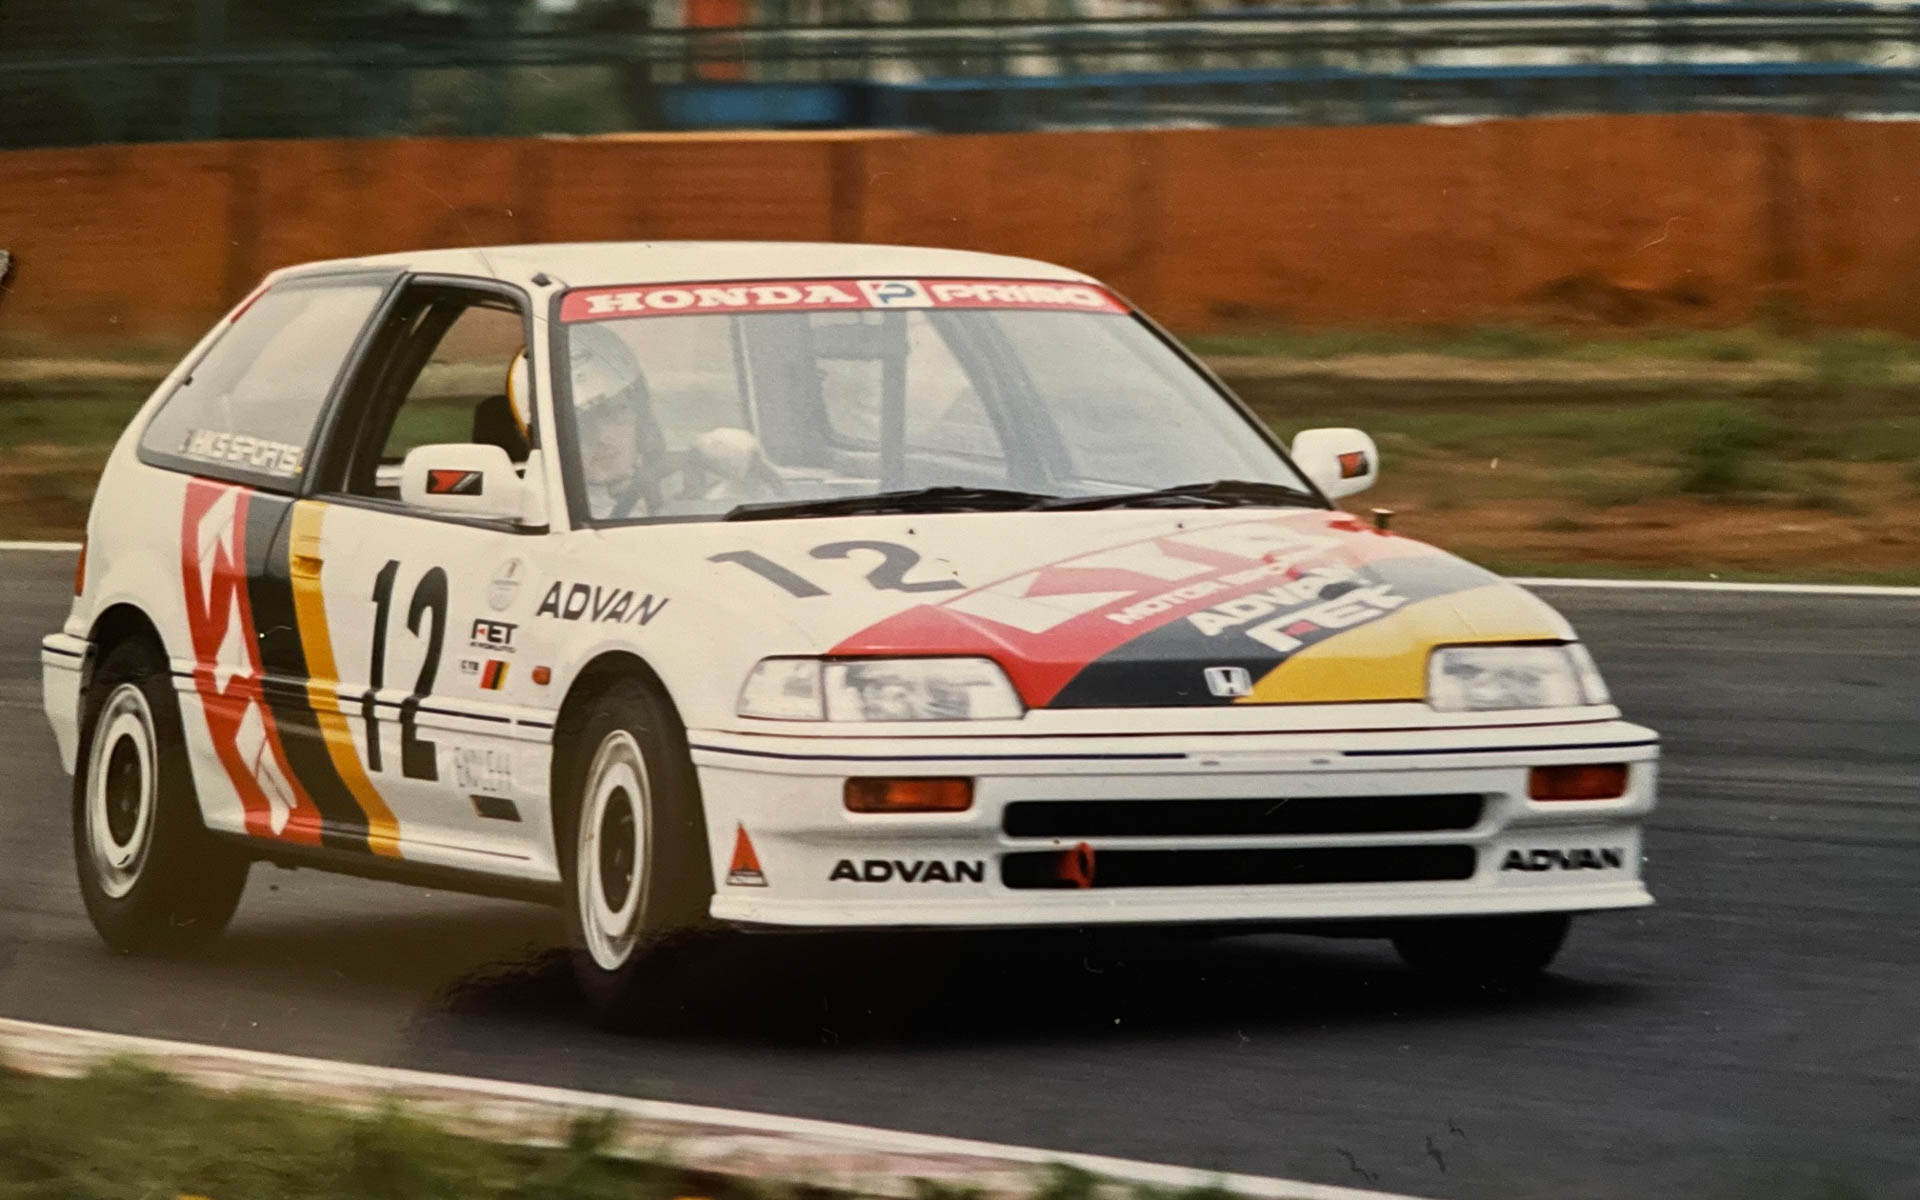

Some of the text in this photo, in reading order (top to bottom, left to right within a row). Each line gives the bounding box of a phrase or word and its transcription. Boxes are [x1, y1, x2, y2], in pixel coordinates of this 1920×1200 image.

[586, 285, 858, 314] HONDA
[930, 284, 1107, 307] PRIMO
[706, 540, 968, 599] 12
[536, 580, 670, 626] ADVAN
[1187, 557, 1372, 636] ADVAN
[471, 618, 519, 645] FET
[361, 559, 449, 782] 12
[829, 859, 985, 883] ADVAN
[1501, 848, 1625, 872] ADVAN
